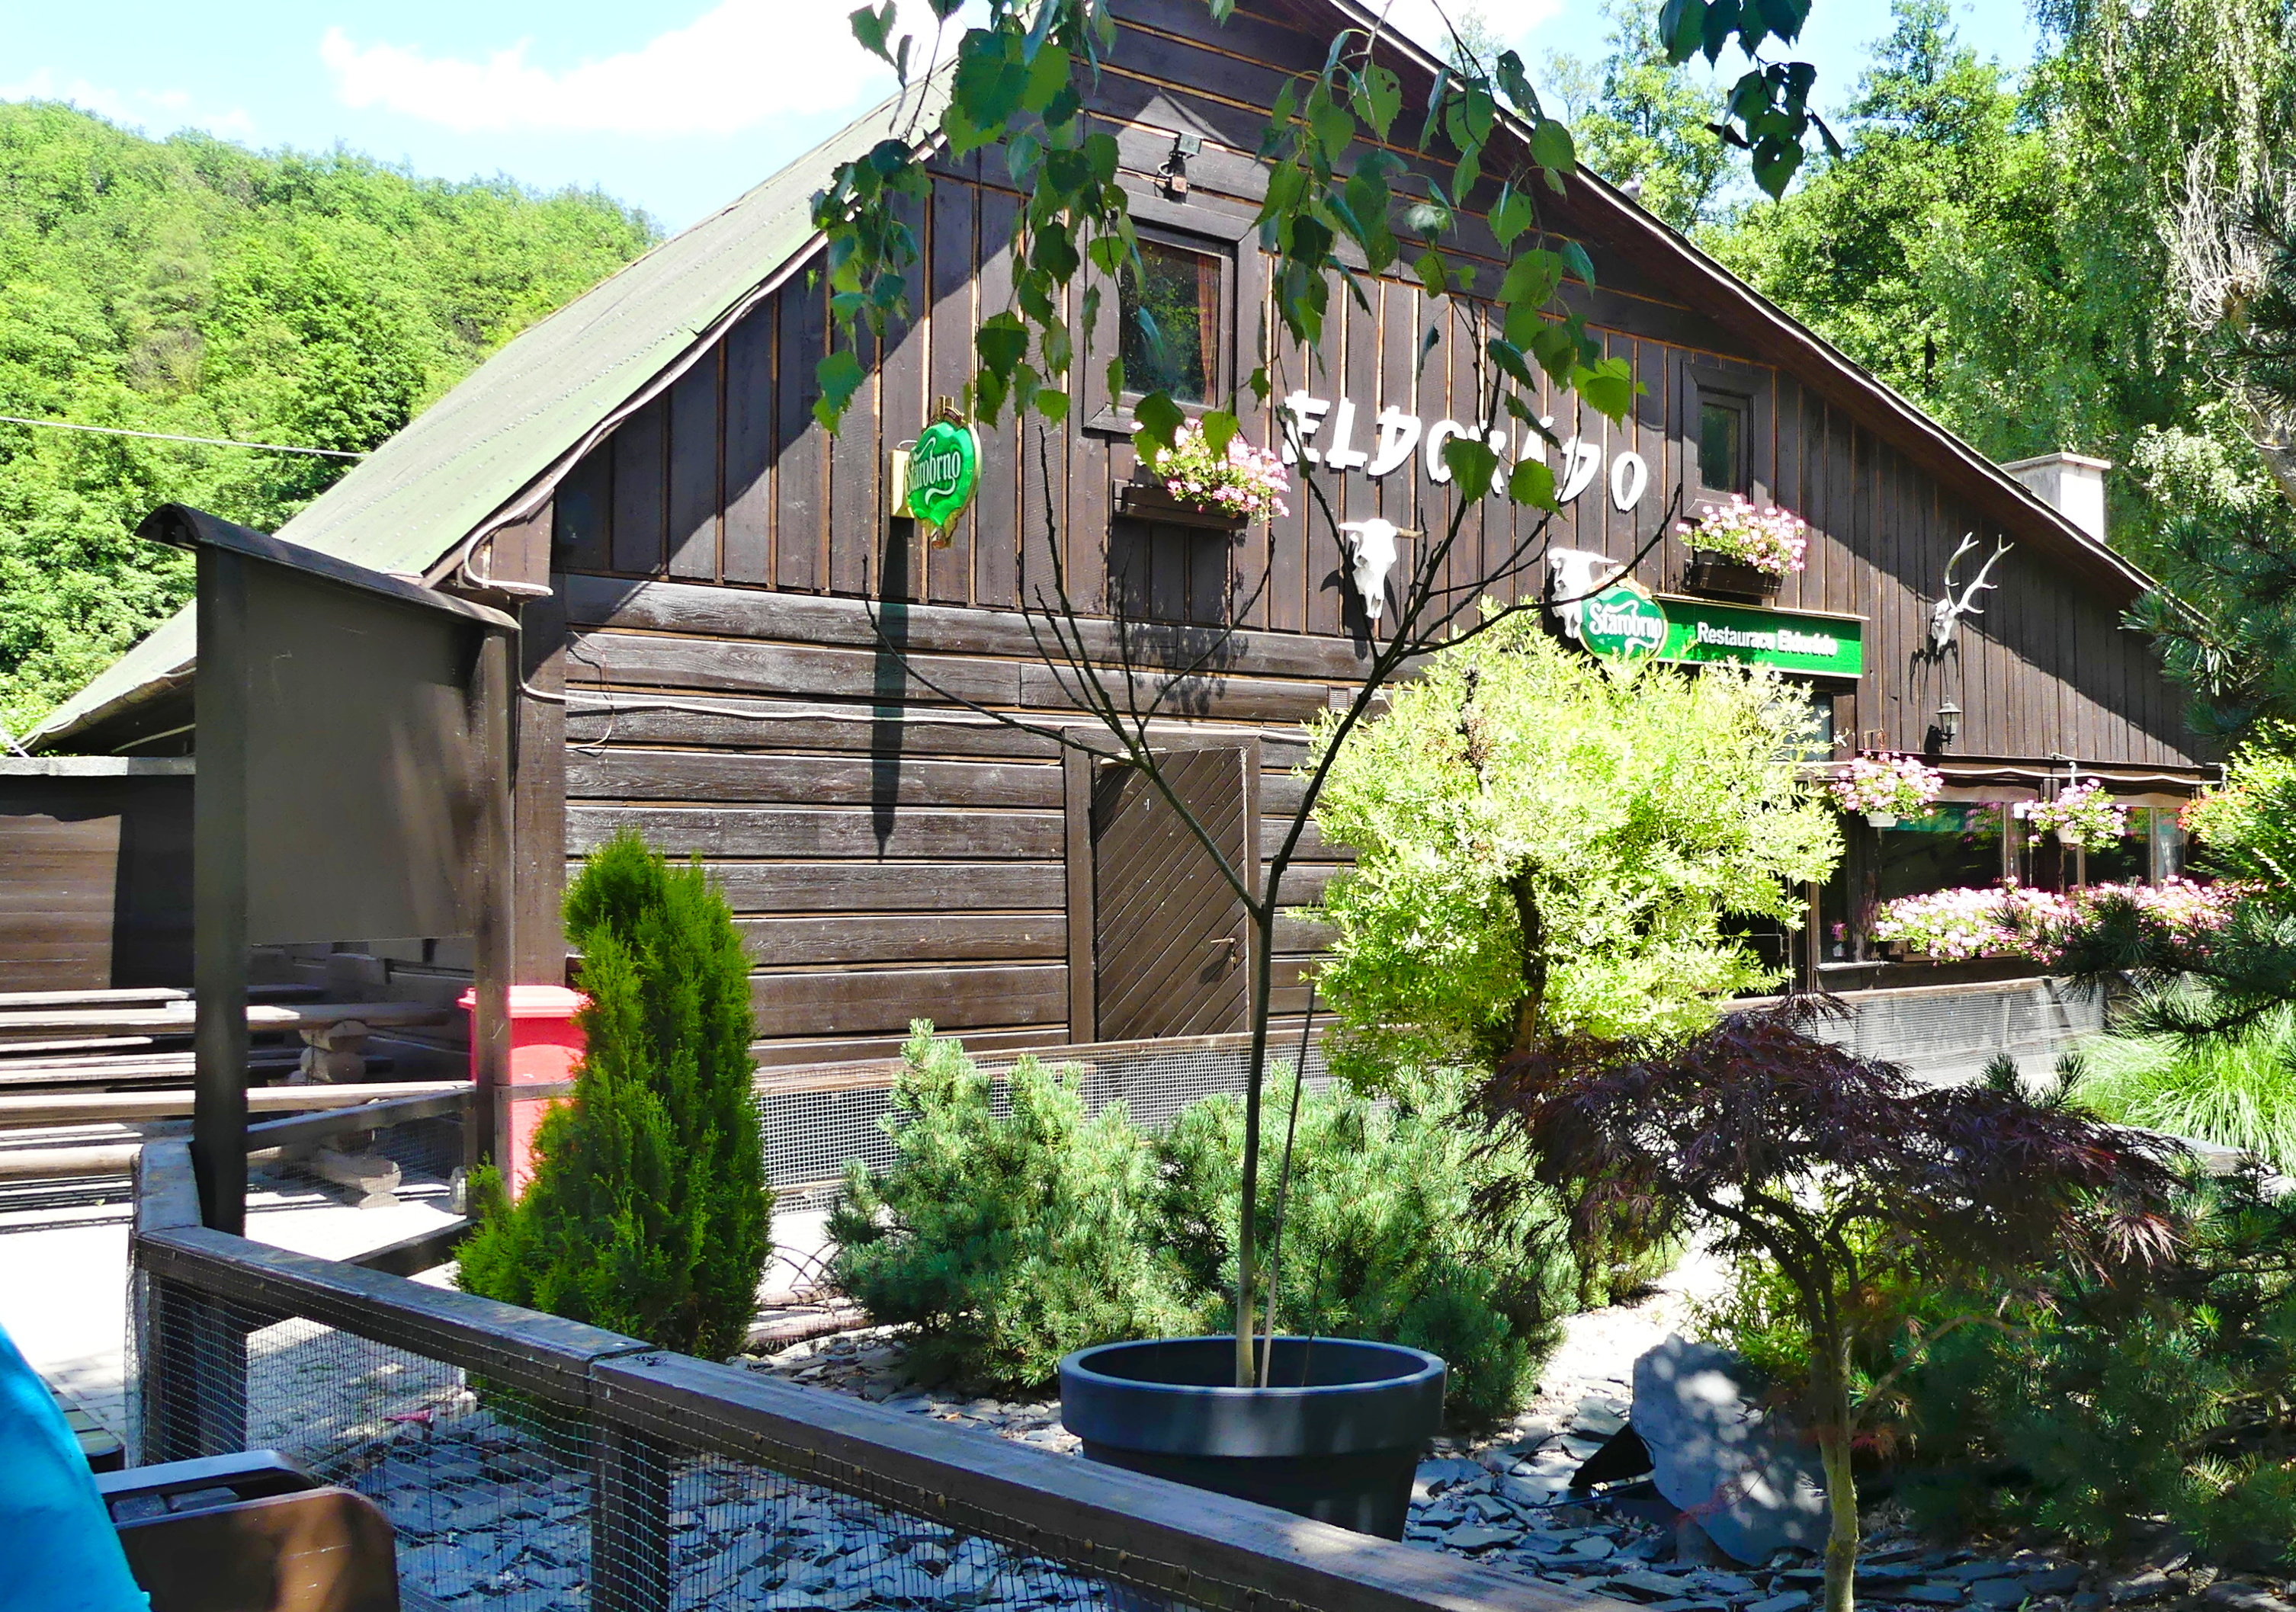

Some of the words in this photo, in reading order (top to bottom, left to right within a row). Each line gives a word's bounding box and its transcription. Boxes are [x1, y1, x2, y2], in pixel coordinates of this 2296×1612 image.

[906, 437, 961, 504] Starobrno
[1589, 599, 1663, 649] Starobrno
[1697, 621, 1776, 649] Restaurace
